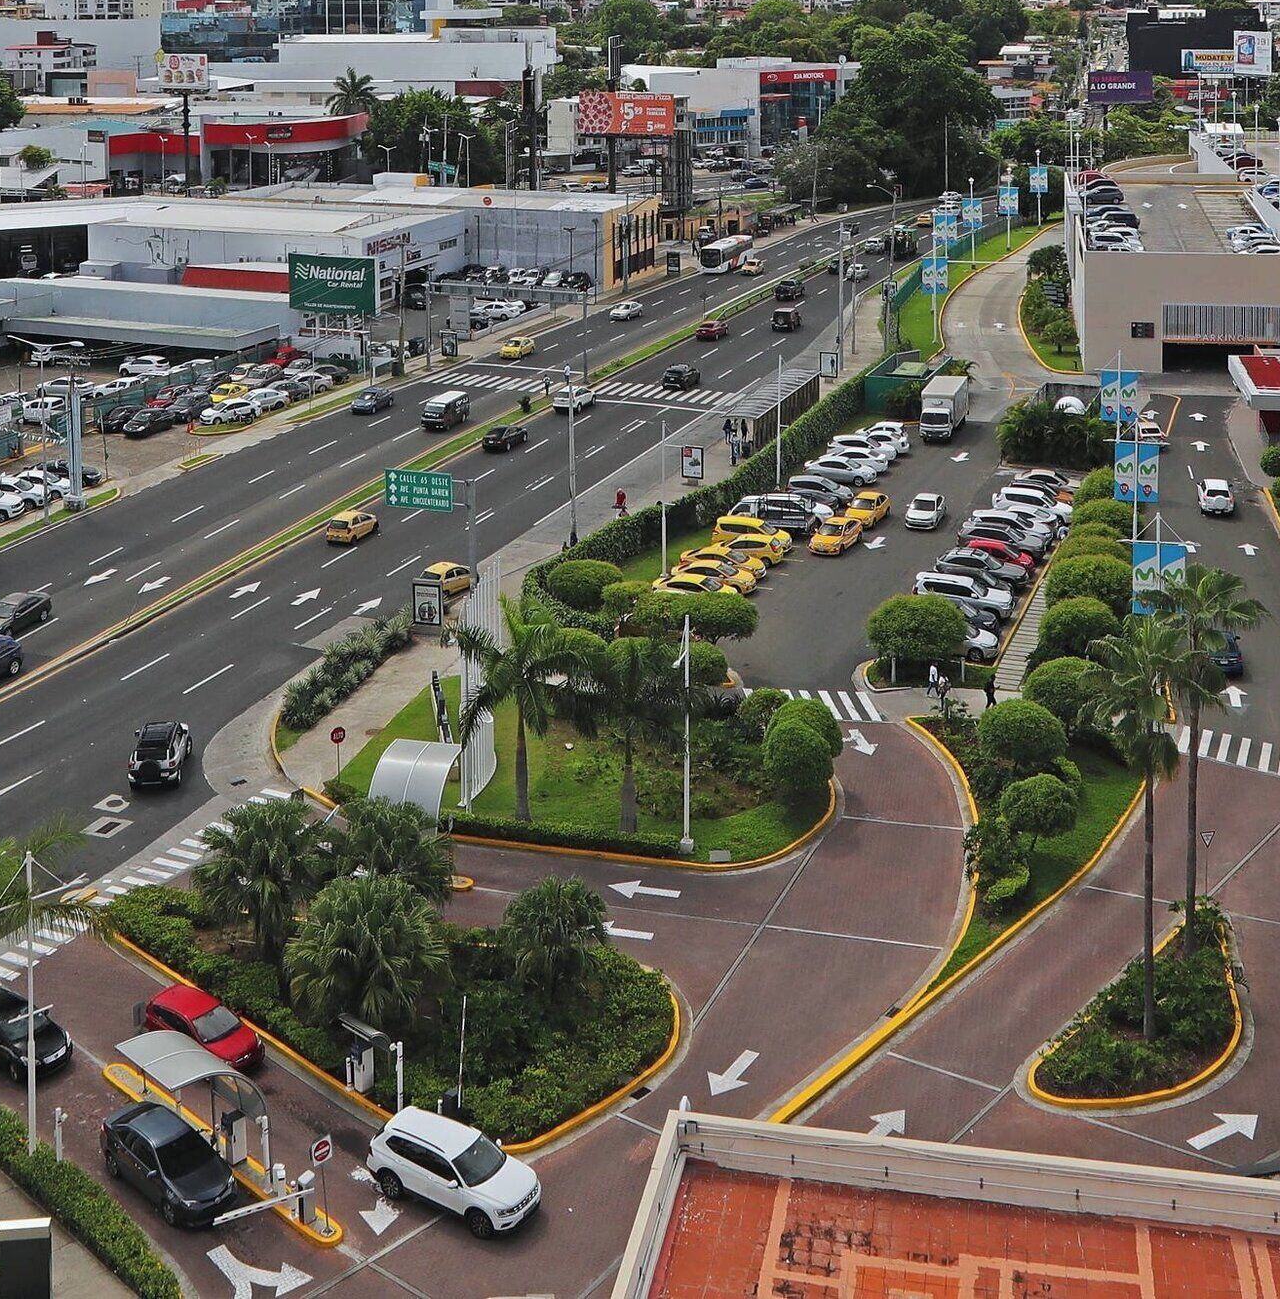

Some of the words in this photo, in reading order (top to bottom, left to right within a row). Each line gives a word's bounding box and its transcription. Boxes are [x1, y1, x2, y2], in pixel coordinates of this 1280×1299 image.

[1107, 82, 1136, 90] GRANDE
[367, 232, 411, 256] NISSAN
[309, 265, 366, 281] National
[340, 281, 363, 289] Rental
[1195, 333, 1245, 343] PARKING
[400, 474, 417, 484] CALLE
[420, 476, 428, 485] 65
[431, 477, 449, 486] OESTE
[413, 486, 429, 495] PUNTA
